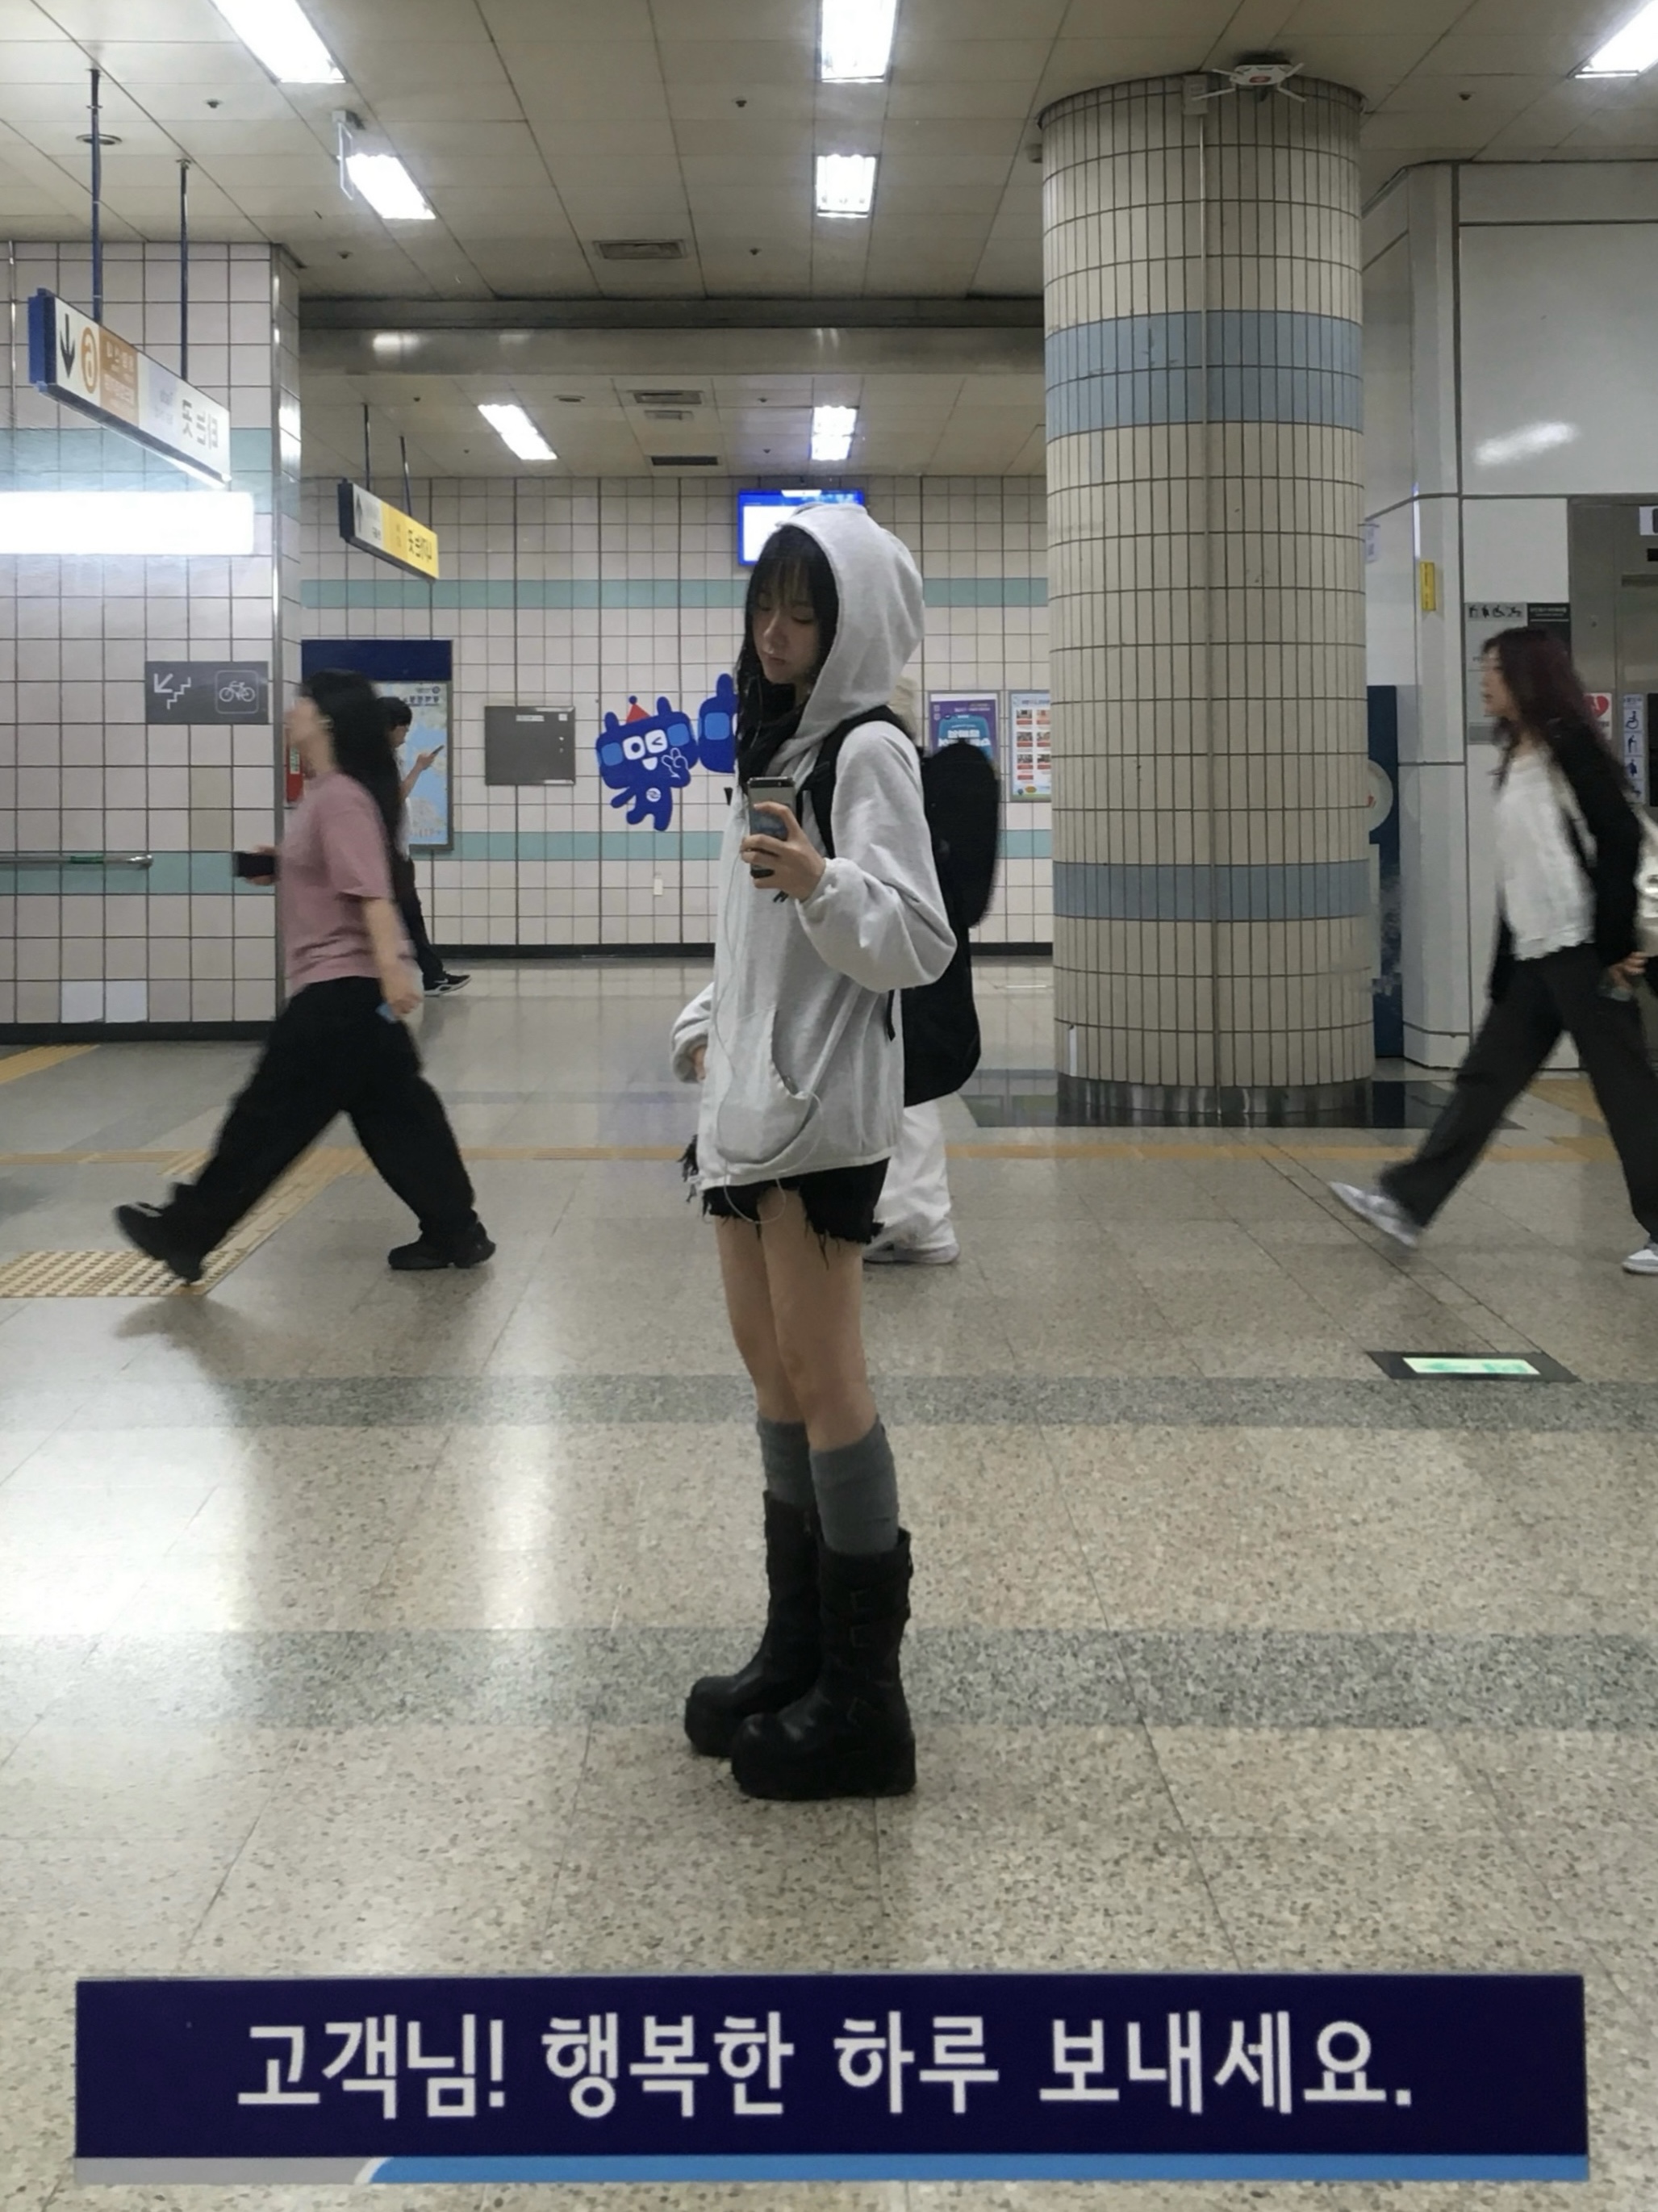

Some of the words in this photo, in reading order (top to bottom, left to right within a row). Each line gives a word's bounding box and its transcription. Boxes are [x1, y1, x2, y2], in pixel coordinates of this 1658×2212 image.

[238, 2014, 503, 2118] 고객님!
[542, 2012, 793, 2117] 행복한
[833, 2011, 998, 2113] 하루
[1040, 2011, 1410, 2113] 보내세요.
